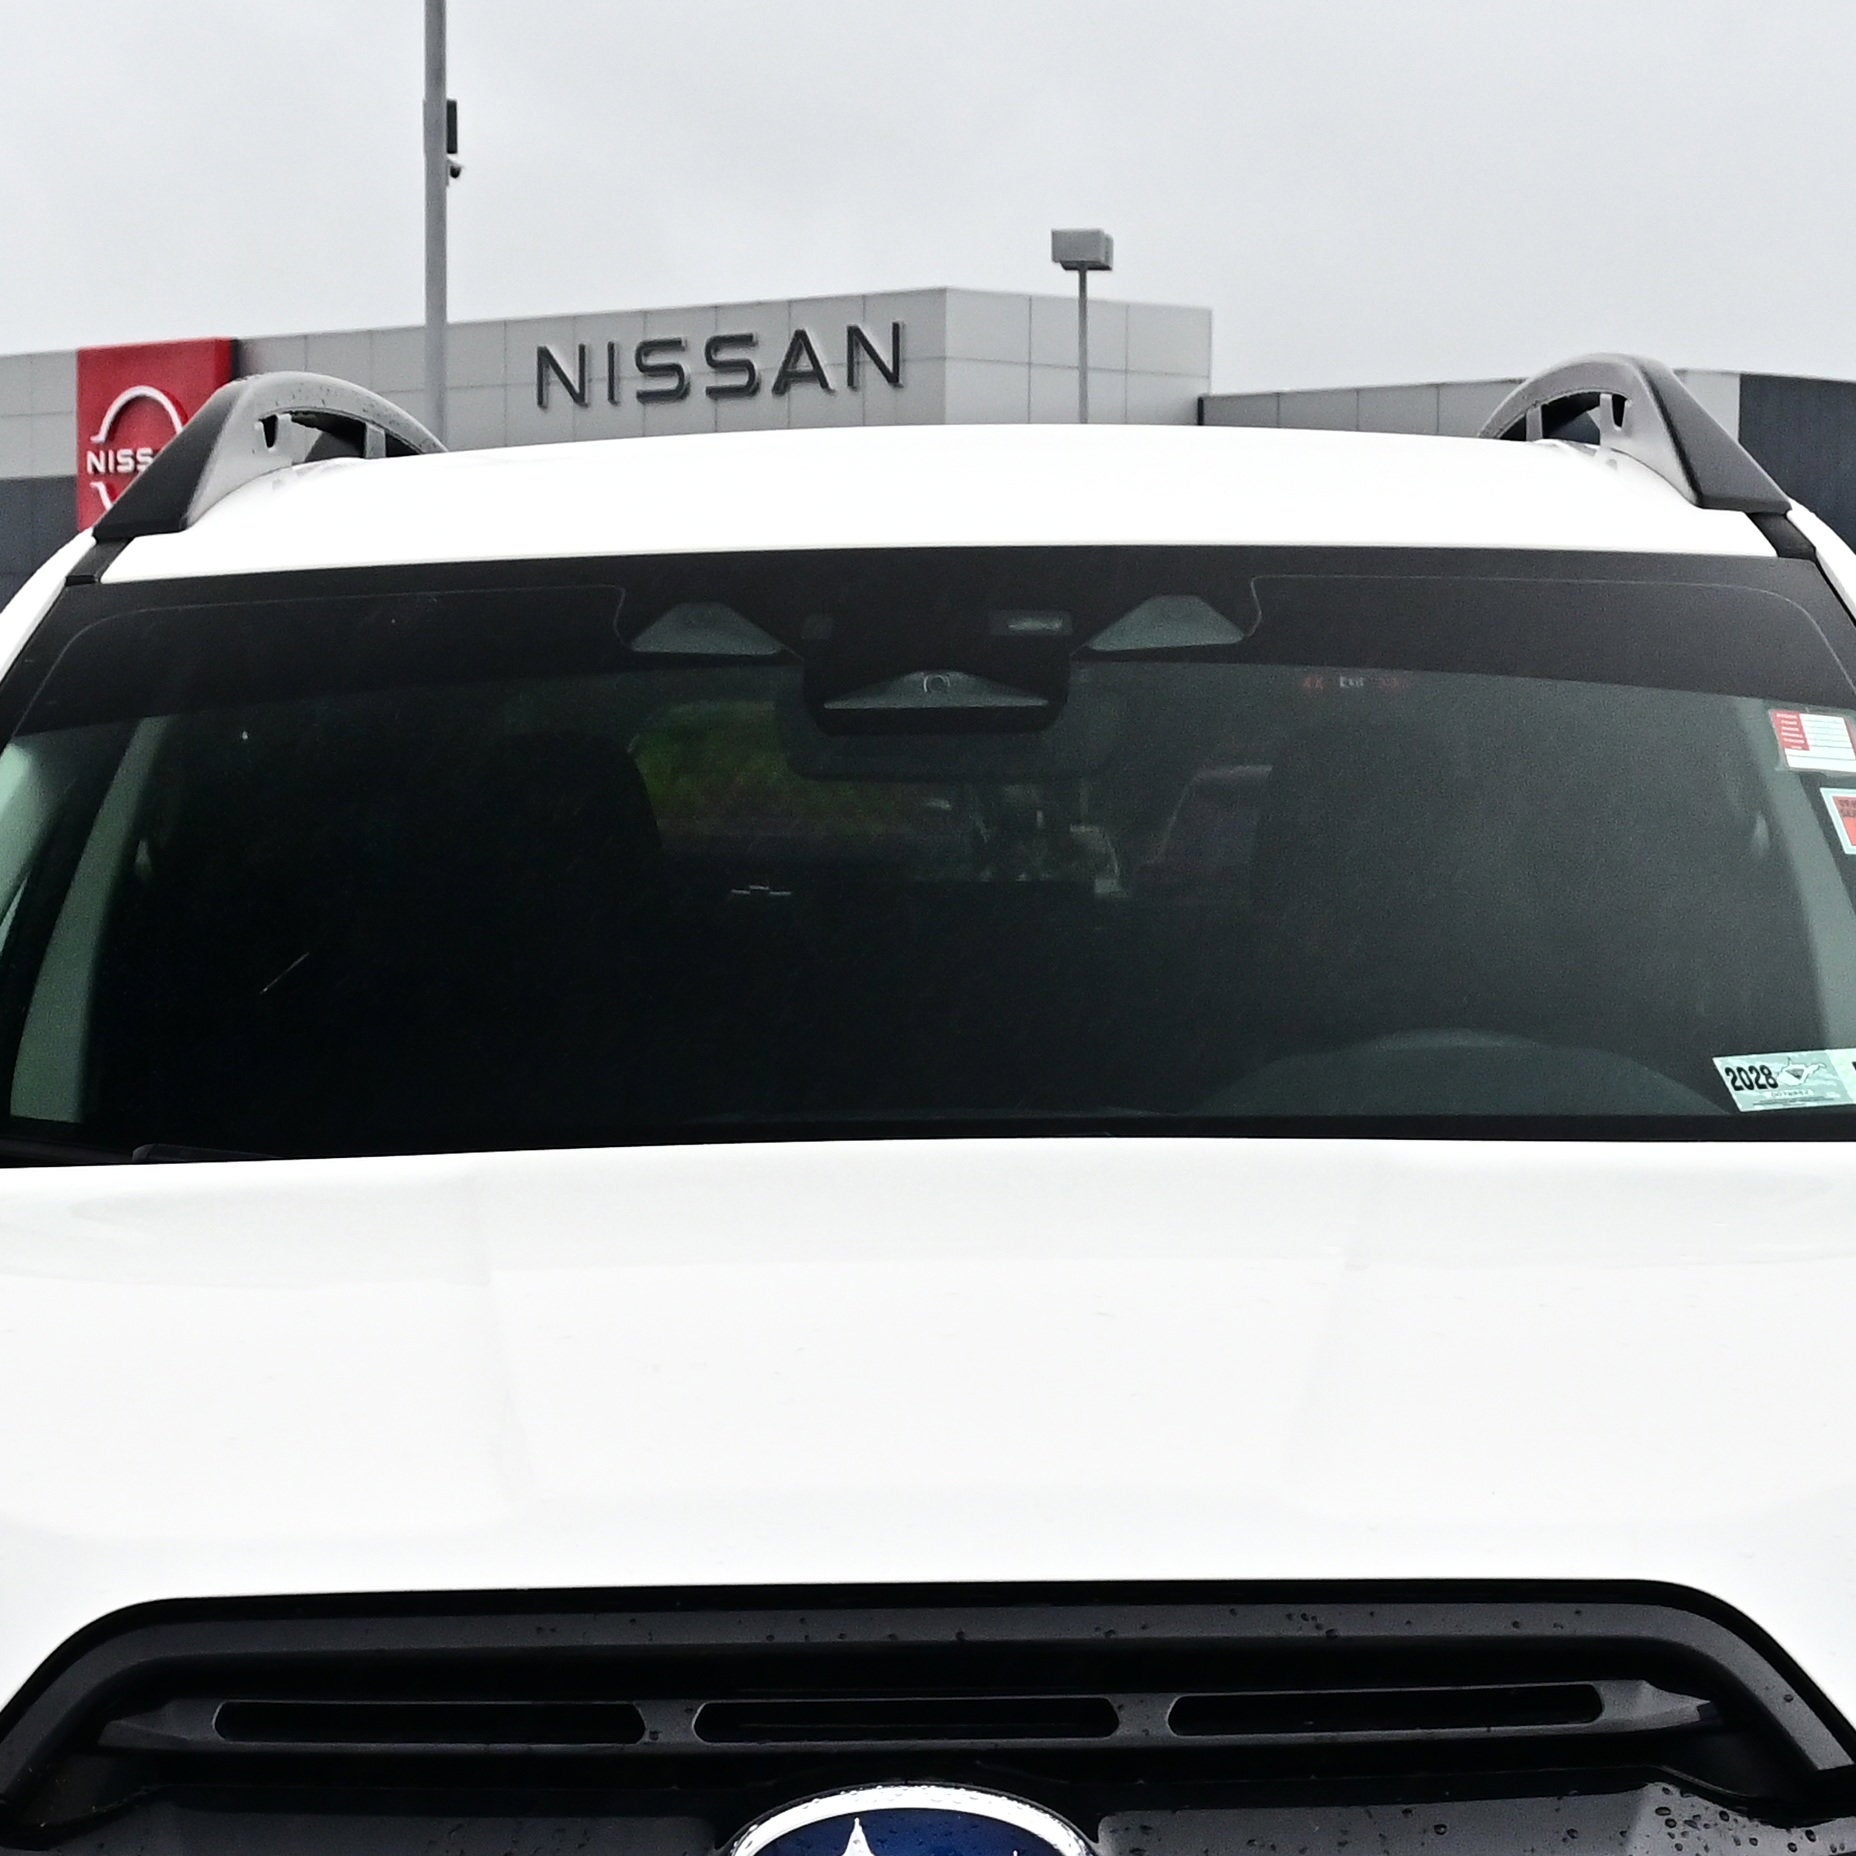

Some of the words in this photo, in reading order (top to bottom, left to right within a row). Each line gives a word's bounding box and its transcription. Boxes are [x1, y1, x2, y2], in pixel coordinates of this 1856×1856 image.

[536, 320, 904, 408] NISSAN
[86, 447, 154, 475] NISS
[1724, 1064, 1779, 1092] 2028
